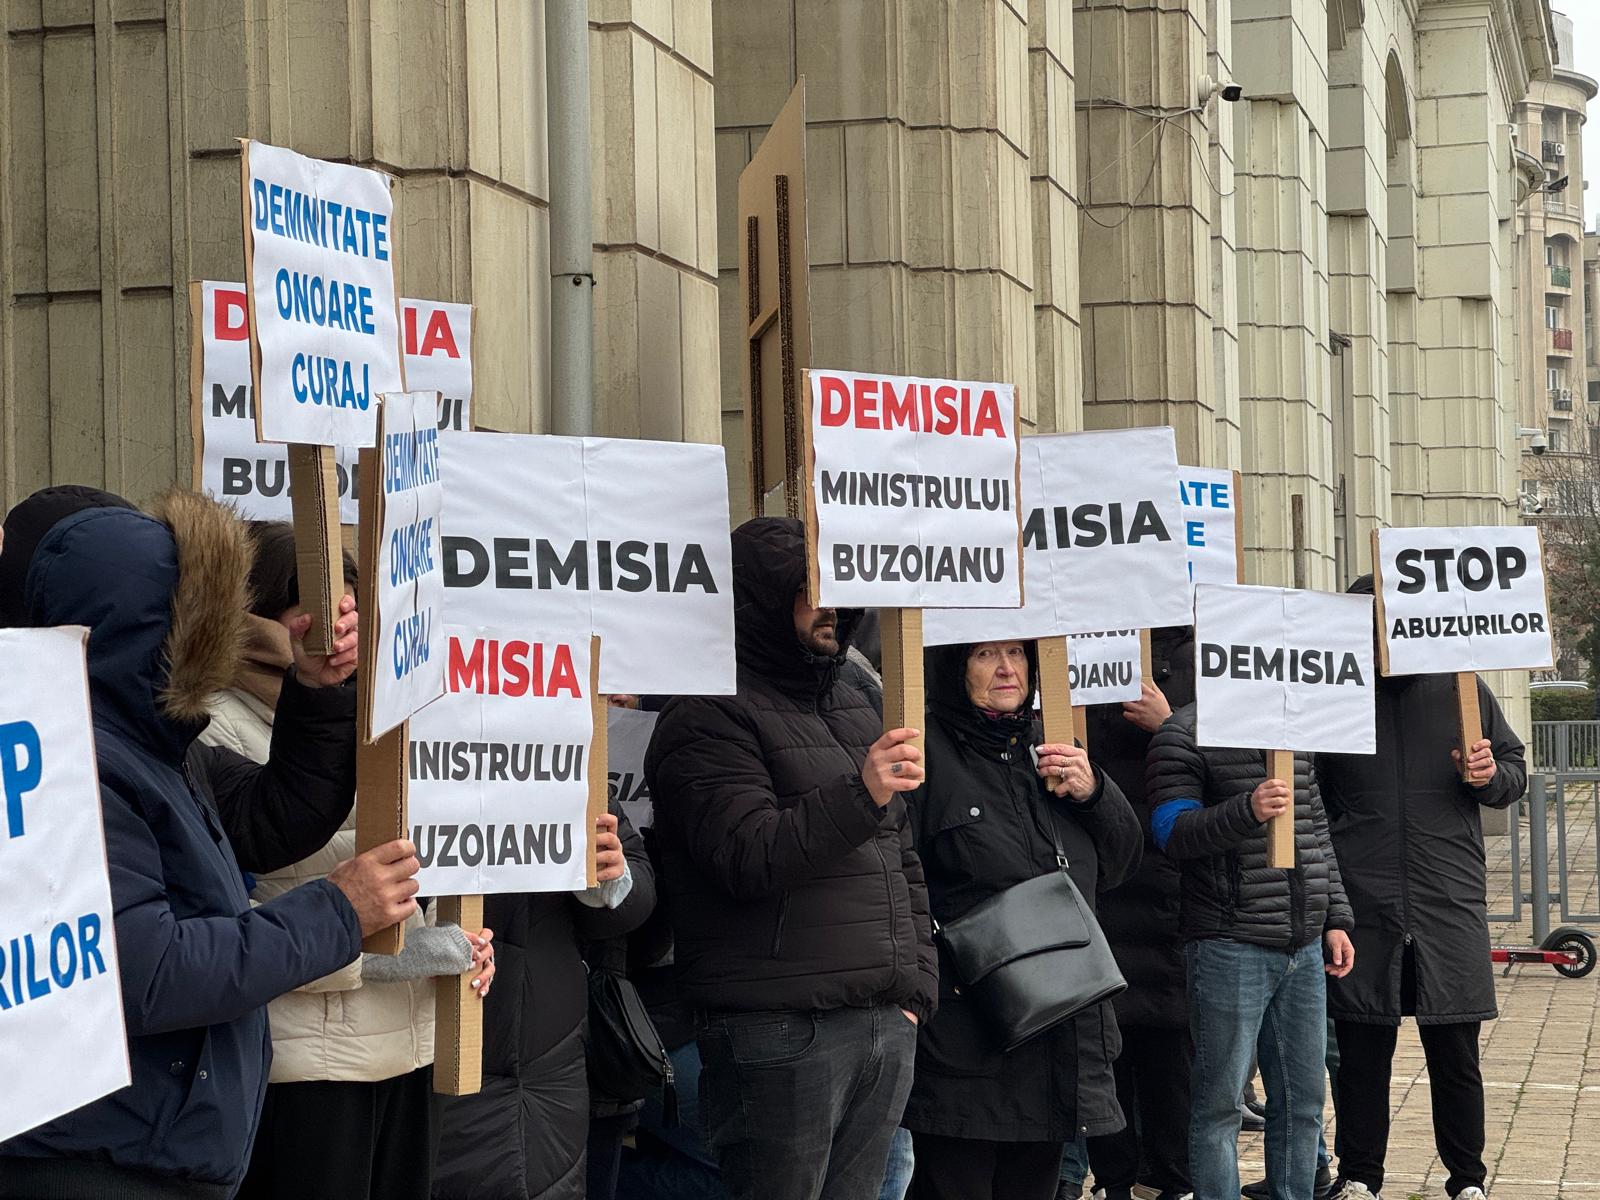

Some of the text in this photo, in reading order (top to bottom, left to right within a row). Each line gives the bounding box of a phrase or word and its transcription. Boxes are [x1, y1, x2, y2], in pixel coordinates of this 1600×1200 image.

[254, 179, 388, 261] DEMNITATE
[276, 268, 375, 334] ONOARE
[292, 353, 369, 411] CURAJ
[821, 377, 1004, 437] DEMISIA
[822, 471, 1009, 510] MINISTRULUI
[391, 519, 432, 586] ONOARE
[441, 536, 718, 593] DEMISIA
[833, 544, 1004, 583] BUZOIANU
[1396, 547, 1526, 594] STOP
[394, 608, 431, 680] CURAJ
[1392, 613, 1544, 639] ABUZURILOR
[1202, 643, 1364, 686] DEMISIA
